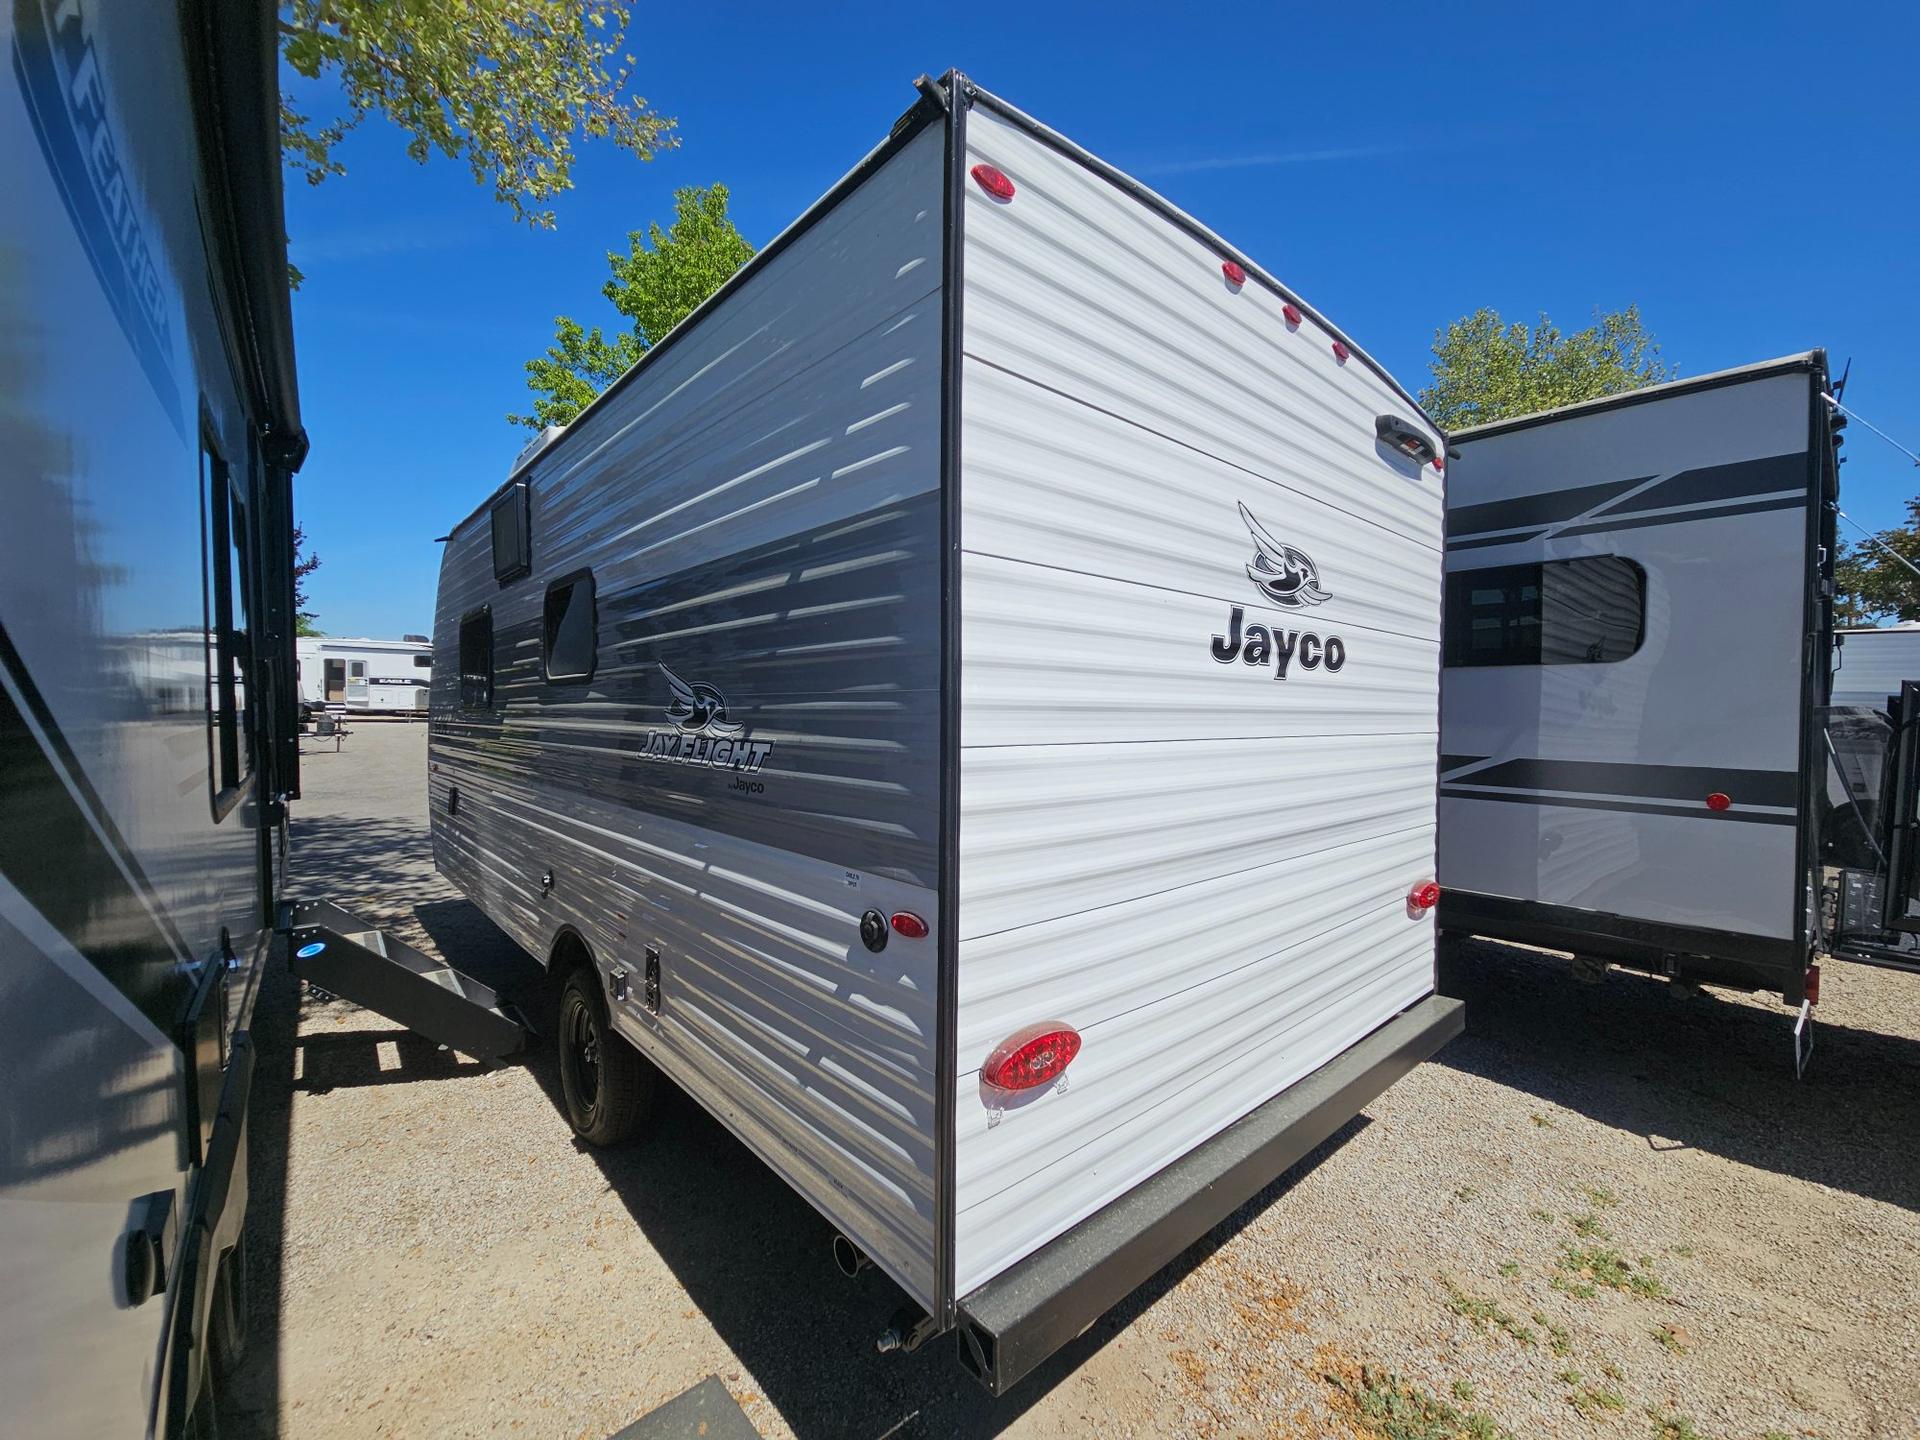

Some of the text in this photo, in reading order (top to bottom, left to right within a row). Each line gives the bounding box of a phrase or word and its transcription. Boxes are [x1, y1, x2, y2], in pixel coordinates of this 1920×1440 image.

[72, 45, 166, 334] FEATHER
[1211, 604, 1346, 680] Jayco
[733, 776, 764, 794] Jayco
